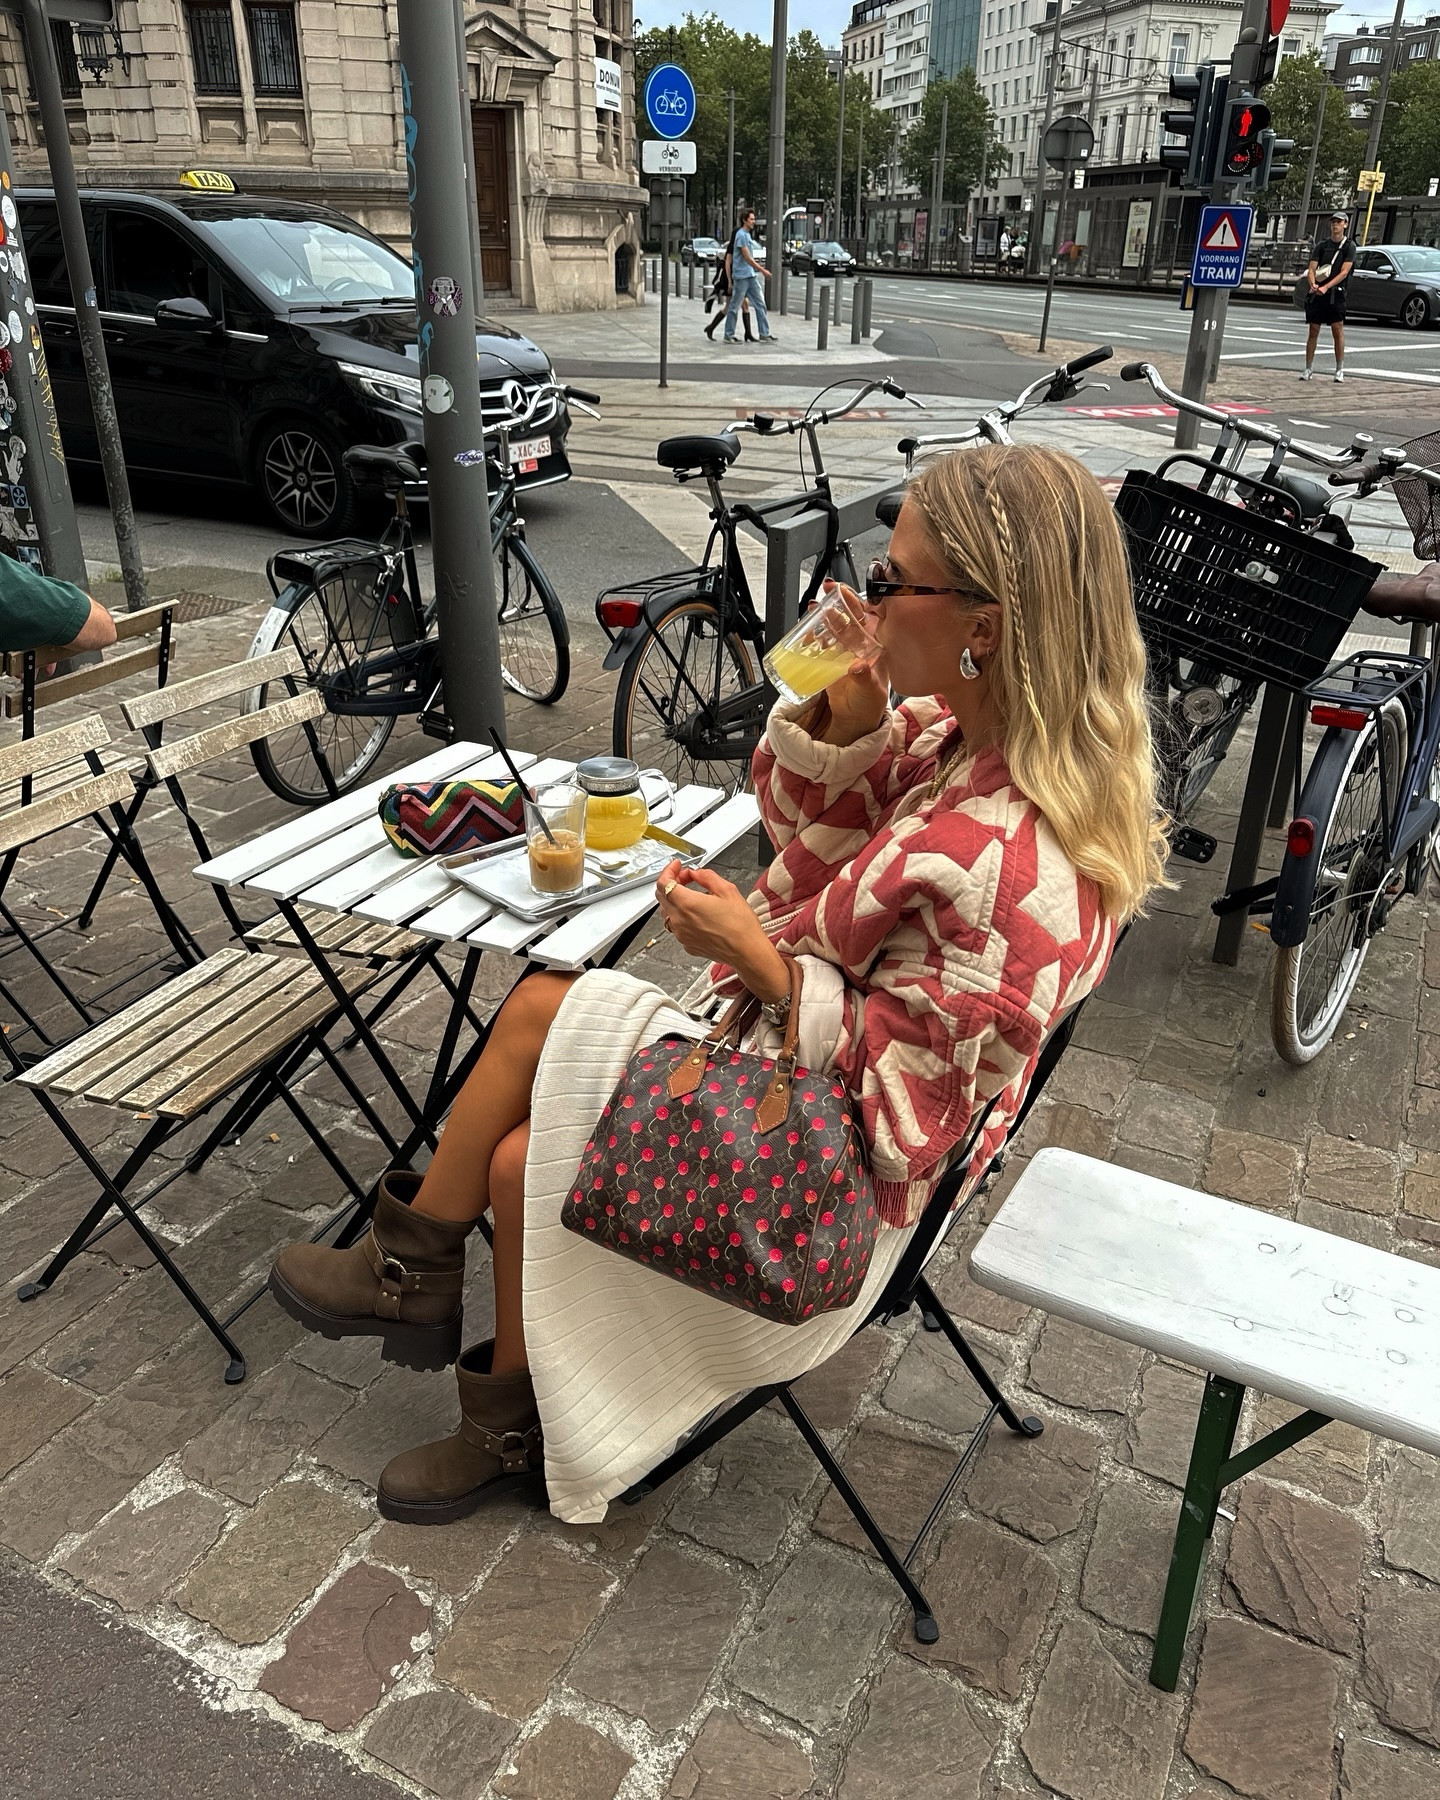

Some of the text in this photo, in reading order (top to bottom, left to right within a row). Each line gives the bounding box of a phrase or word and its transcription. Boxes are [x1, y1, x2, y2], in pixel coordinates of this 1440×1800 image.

[196, 173, 230, 187] TAXI
[1200, 255, 1240, 264] VOORRANG
[1199, 266, 1237, 280] TRAM
